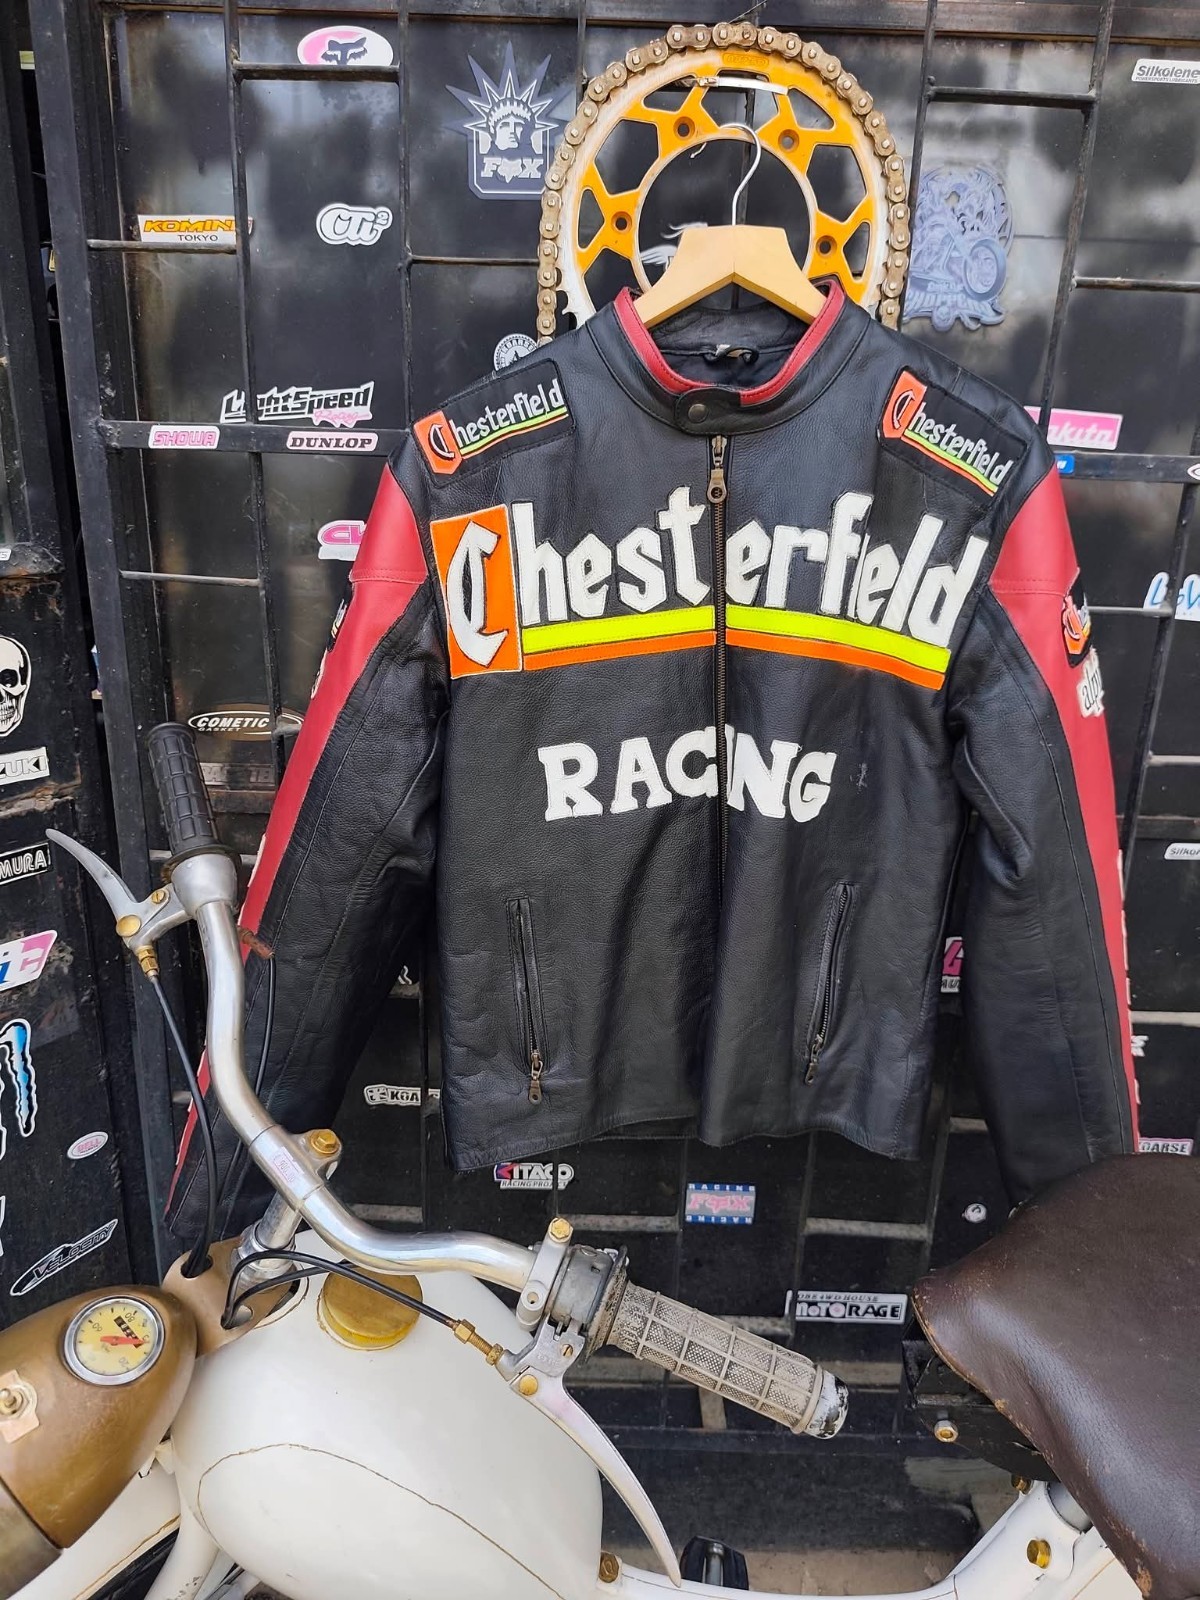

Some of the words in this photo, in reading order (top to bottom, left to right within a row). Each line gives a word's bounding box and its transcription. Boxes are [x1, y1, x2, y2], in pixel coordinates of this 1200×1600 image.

[1136, 65, 1200, 78] Silkolene
[144, 219, 236, 233] KOMIN
[178, 234, 219, 242] TOKYO
[222, 385, 372, 421] LhtSpeed
[428, 378, 565, 460] Chesterfield
[153, 431, 217, 446] SHOWA
[892, 389, 1014, 486] Chesterfield
[1048, 421, 1113, 444] akita
[289, 437, 373, 449] DUNLOP
[445, 485, 990, 669] Chesterfield
[196, 717, 270, 728] COMETIC
[537, 723, 838, 823] RACING
[688, 1184, 756, 1192] RACING
